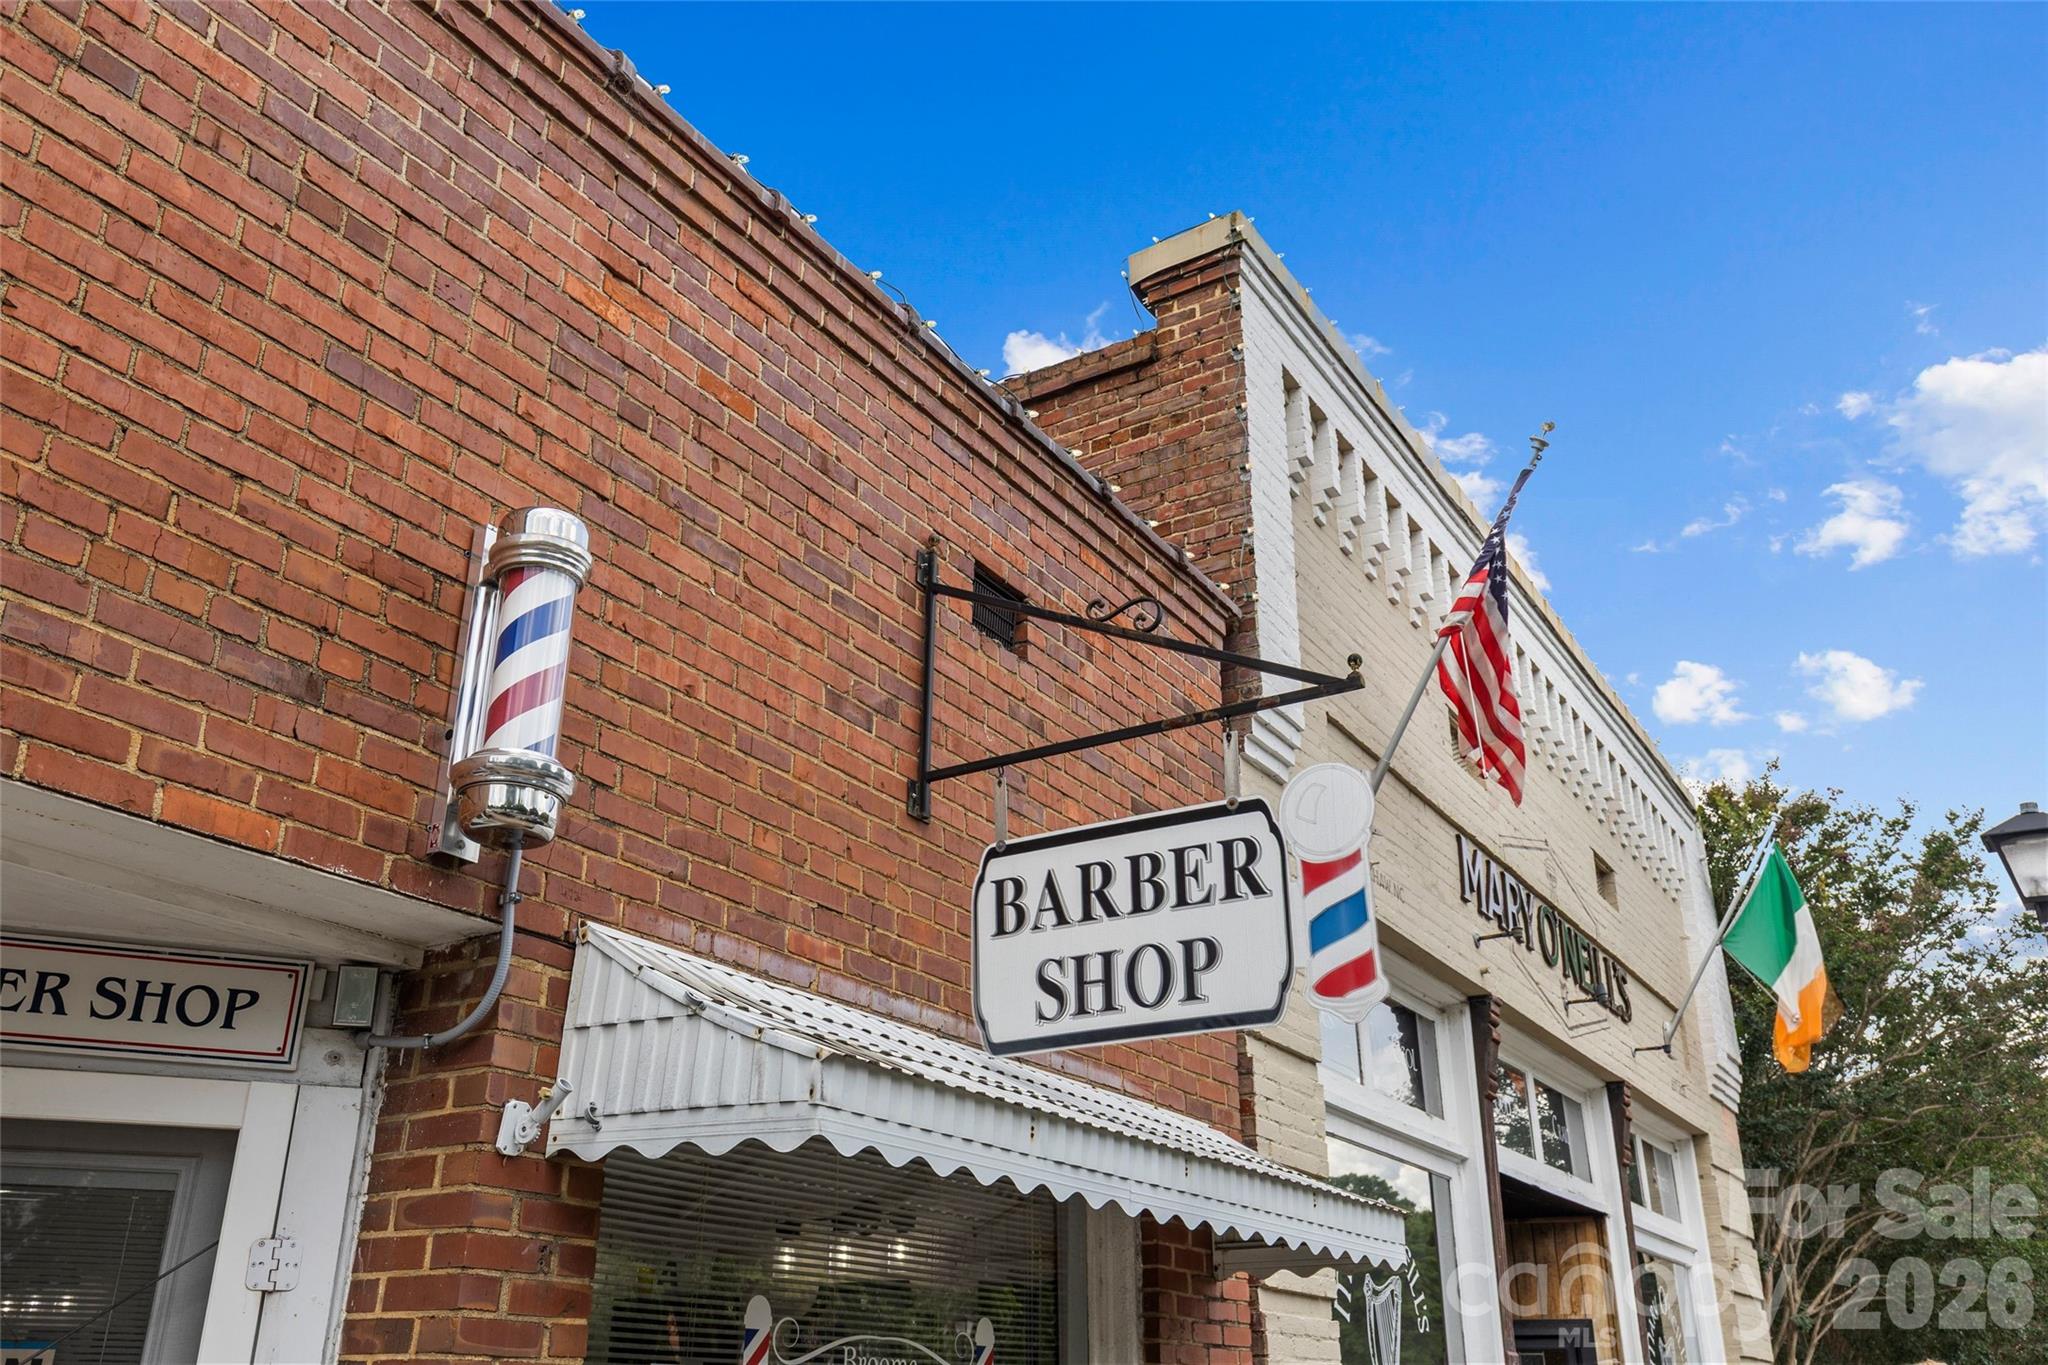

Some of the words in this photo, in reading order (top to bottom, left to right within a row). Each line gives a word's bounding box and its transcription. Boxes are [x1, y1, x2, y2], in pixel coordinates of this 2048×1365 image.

[990, 835, 1274, 940] BARBER
[1455, 833, 1534, 952] MARY
[0, 967, 71, 1016] ER
[89, 975, 261, 1031] SHOP
[1035, 935, 1224, 1026] SHOP
